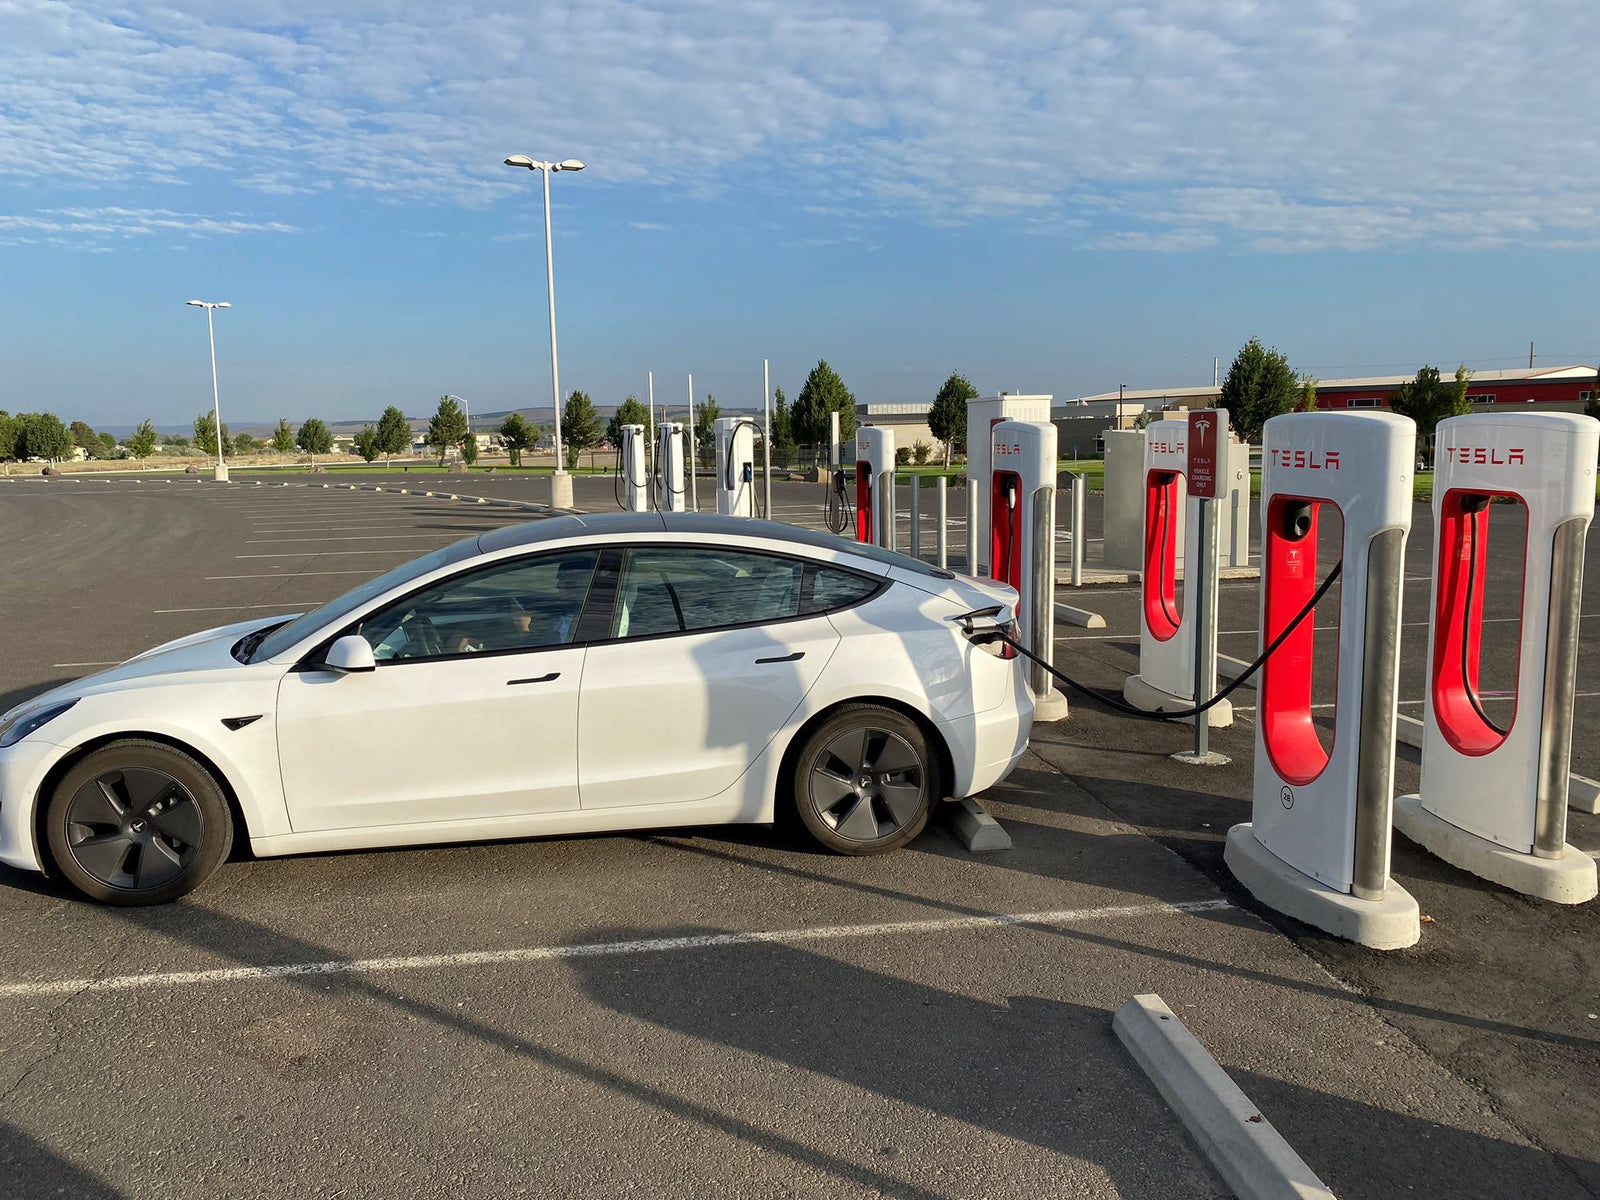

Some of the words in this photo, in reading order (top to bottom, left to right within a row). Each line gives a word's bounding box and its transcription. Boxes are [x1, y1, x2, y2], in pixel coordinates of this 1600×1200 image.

[1149, 442, 1184, 454] TESLA
[1271, 449, 1340, 470] TESLA
[1446, 447, 1525, 466] TESLA
[1191, 474, 1212, 482] CHARGING
